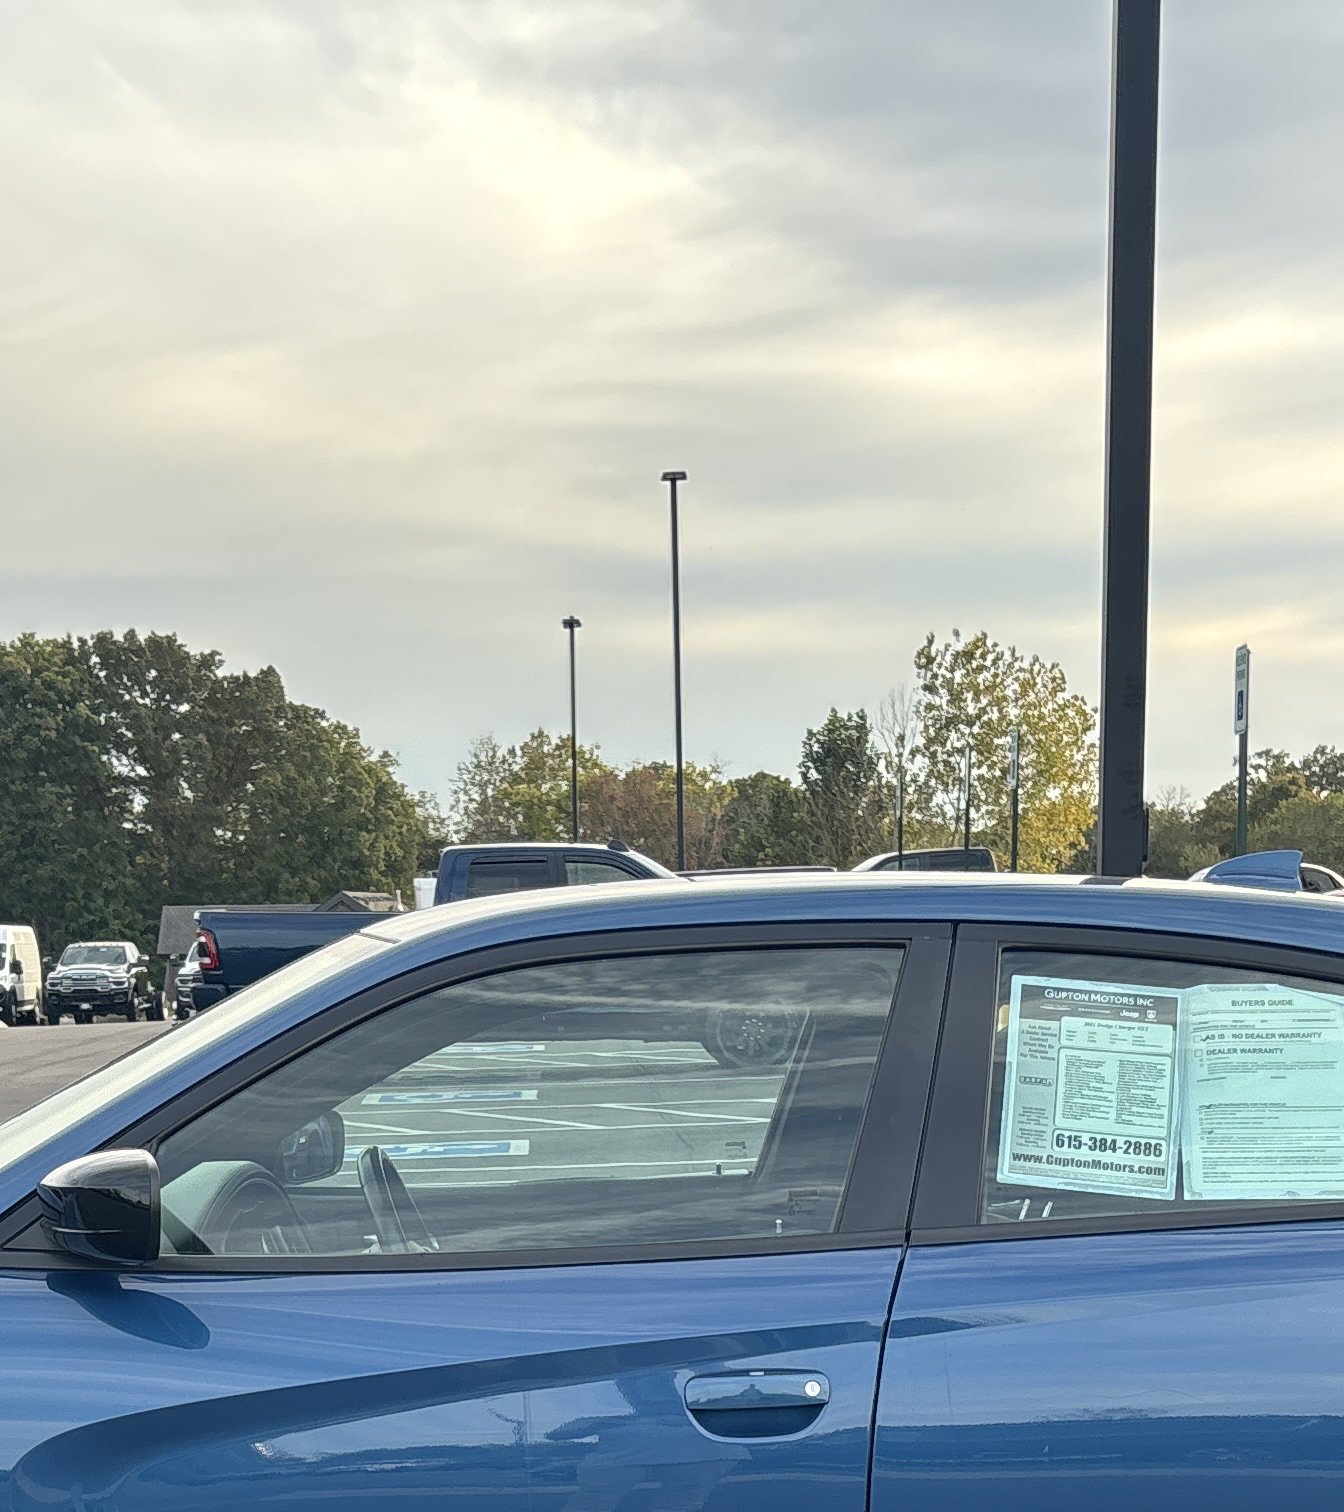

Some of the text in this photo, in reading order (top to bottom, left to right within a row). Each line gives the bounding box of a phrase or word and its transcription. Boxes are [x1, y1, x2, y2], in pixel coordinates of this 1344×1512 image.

[1044, 988, 1155, 1007] GUPTON MOTORS INC
[1206, 1047, 1284, 1056] DEALER WARRANTY
[1055, 1133, 1163, 1158] 615-384-2886
[1012, 1152, 1166, 1177] www.GuptonMotors.com
